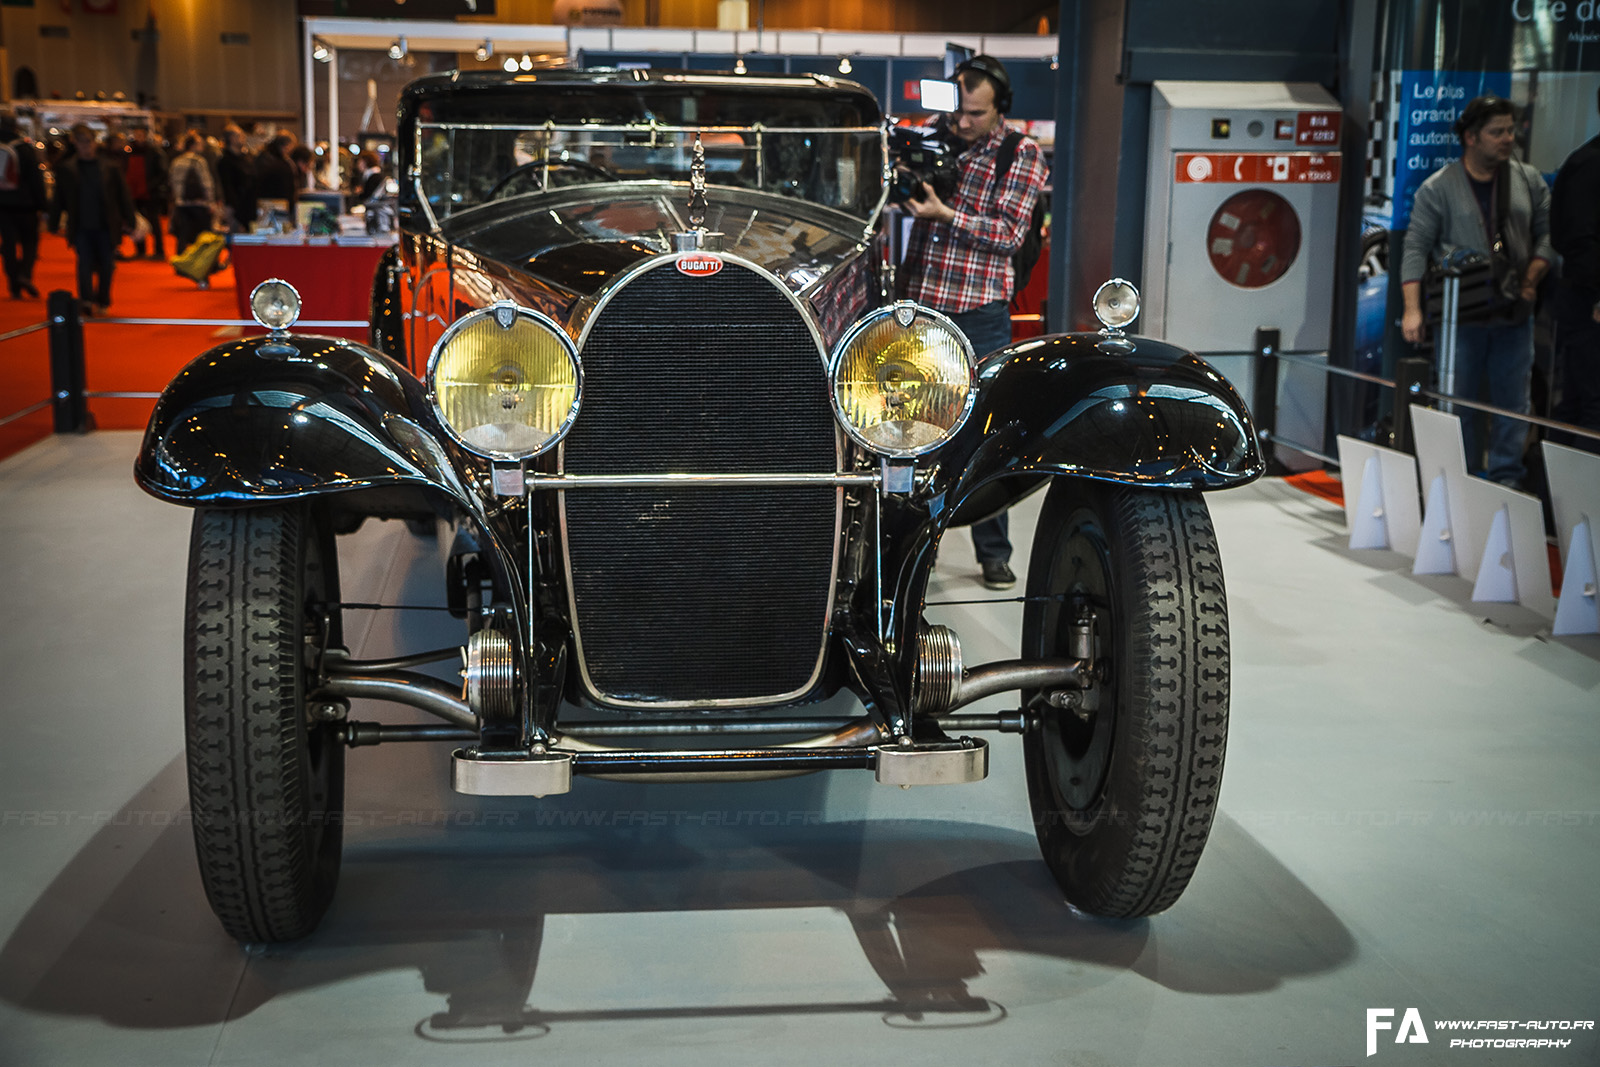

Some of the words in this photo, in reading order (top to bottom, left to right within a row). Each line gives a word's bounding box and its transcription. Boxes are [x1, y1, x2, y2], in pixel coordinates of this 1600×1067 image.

[1576, 0, 1600, 22] d
[1413, 82, 1435, 99] Le
[1436, 83, 1465, 102] plus
[1410, 106, 1456, 126] grand
[1407, 154, 1429, 169] du
[680, 260, 719, 271] BUGATTI
